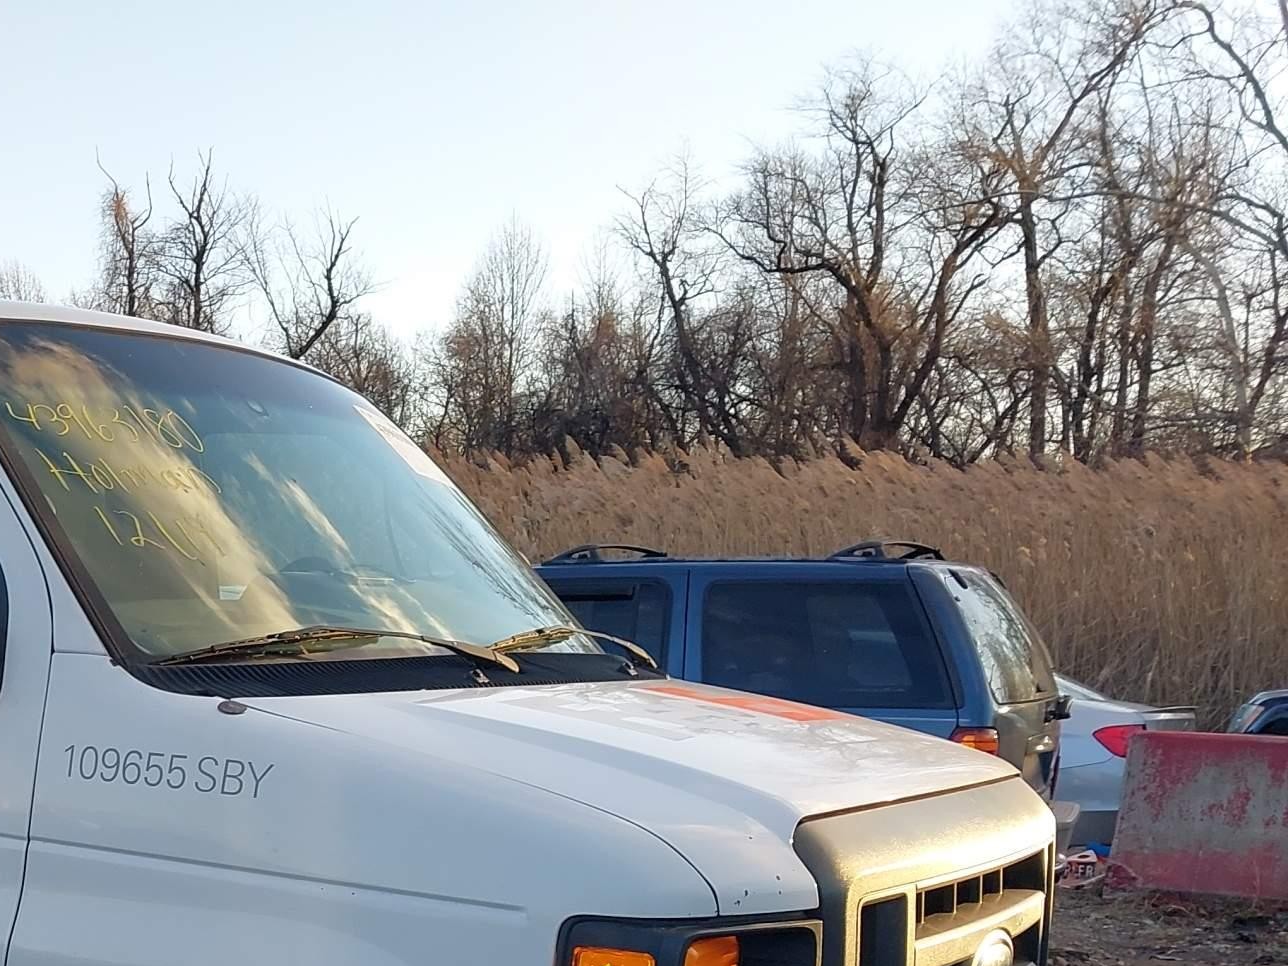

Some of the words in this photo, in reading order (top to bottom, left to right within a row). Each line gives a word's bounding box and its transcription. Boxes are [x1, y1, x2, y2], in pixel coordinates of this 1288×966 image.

[5, 401, 205, 453] 43963180
[64, 744, 189, 790] 109655
[194, 756, 275, 799] SBY
